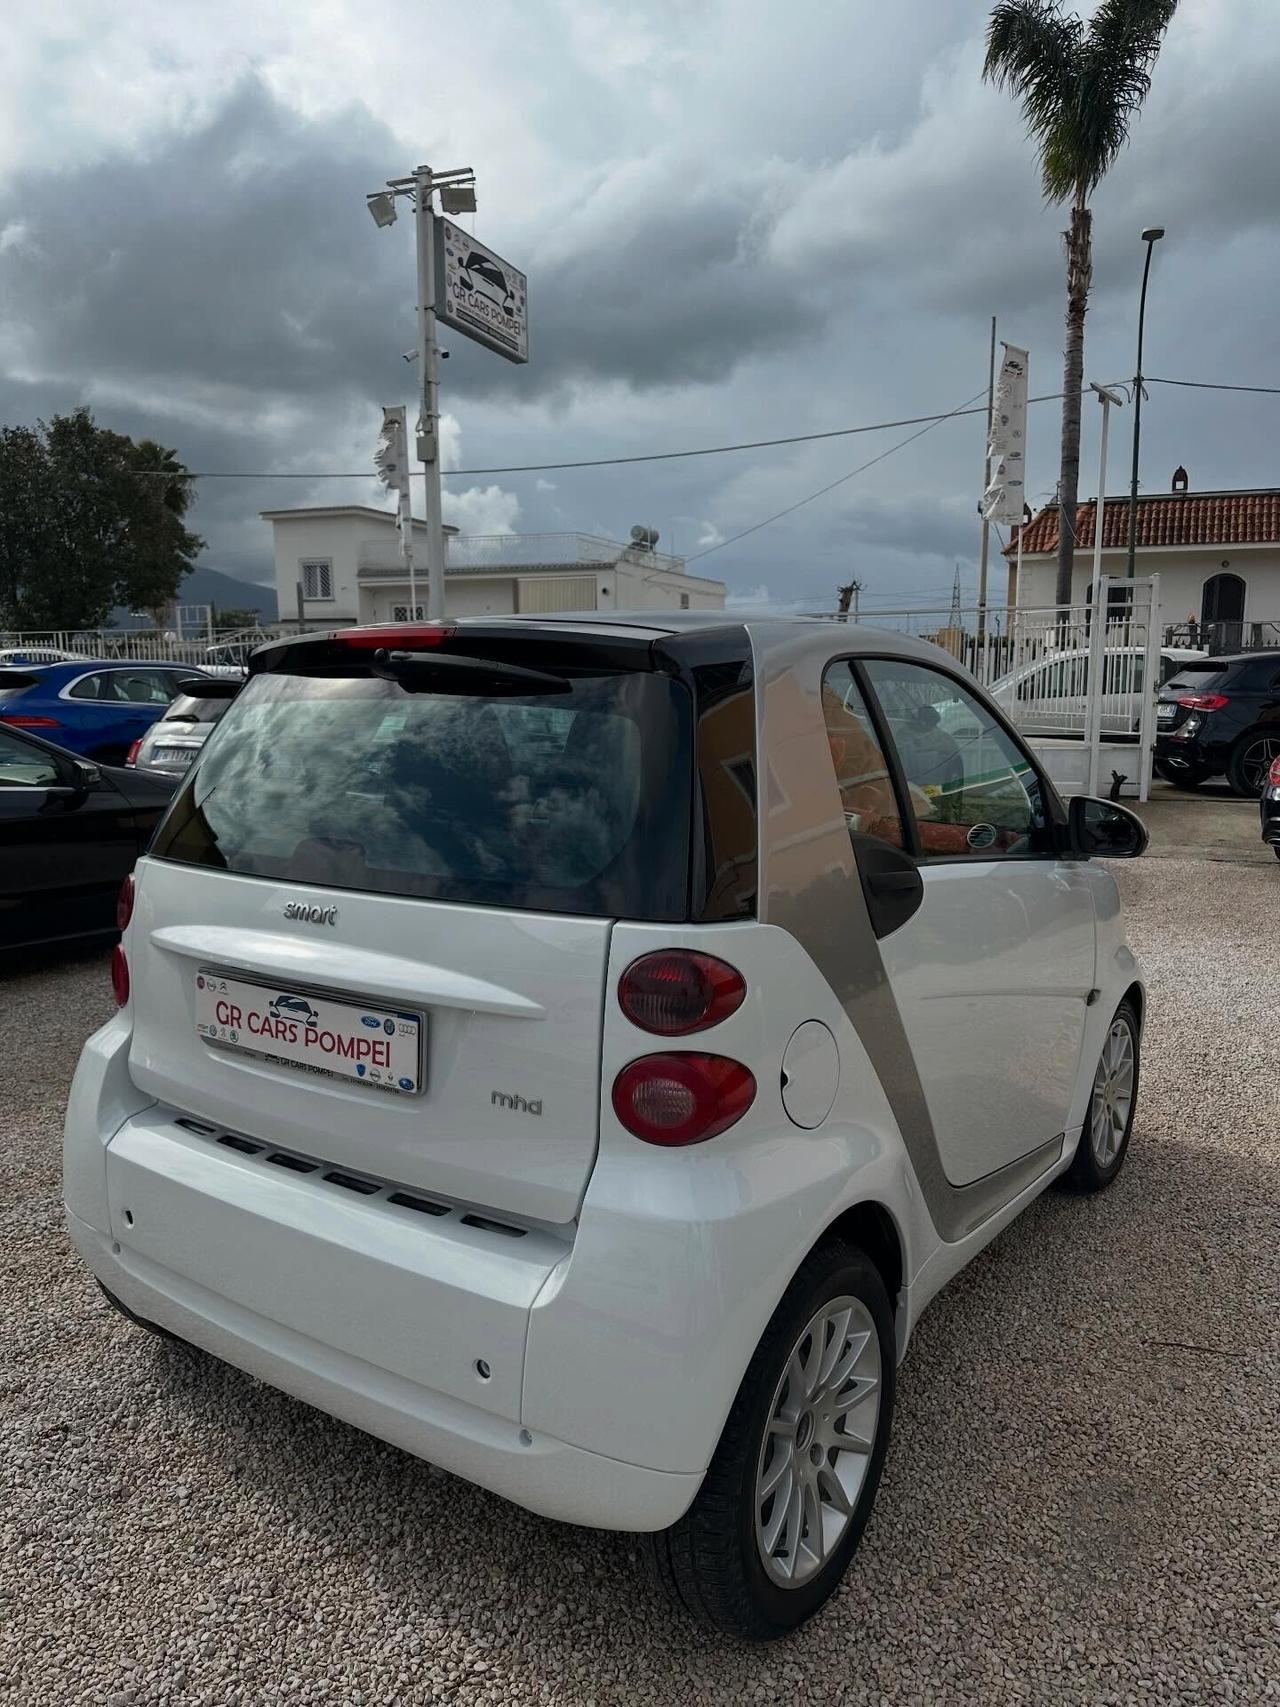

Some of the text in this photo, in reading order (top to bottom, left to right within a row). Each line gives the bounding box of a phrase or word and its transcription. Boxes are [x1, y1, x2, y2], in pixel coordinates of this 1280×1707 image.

[452, 282, 466, 304] GR
[467, 293, 490, 317] CARS
[491, 308, 521, 336] POMPEI
[283, 901, 338, 926] smart
[215, 1000, 391, 1068] GR CARS POMPEI
[491, 1090, 543, 1116] mhd
